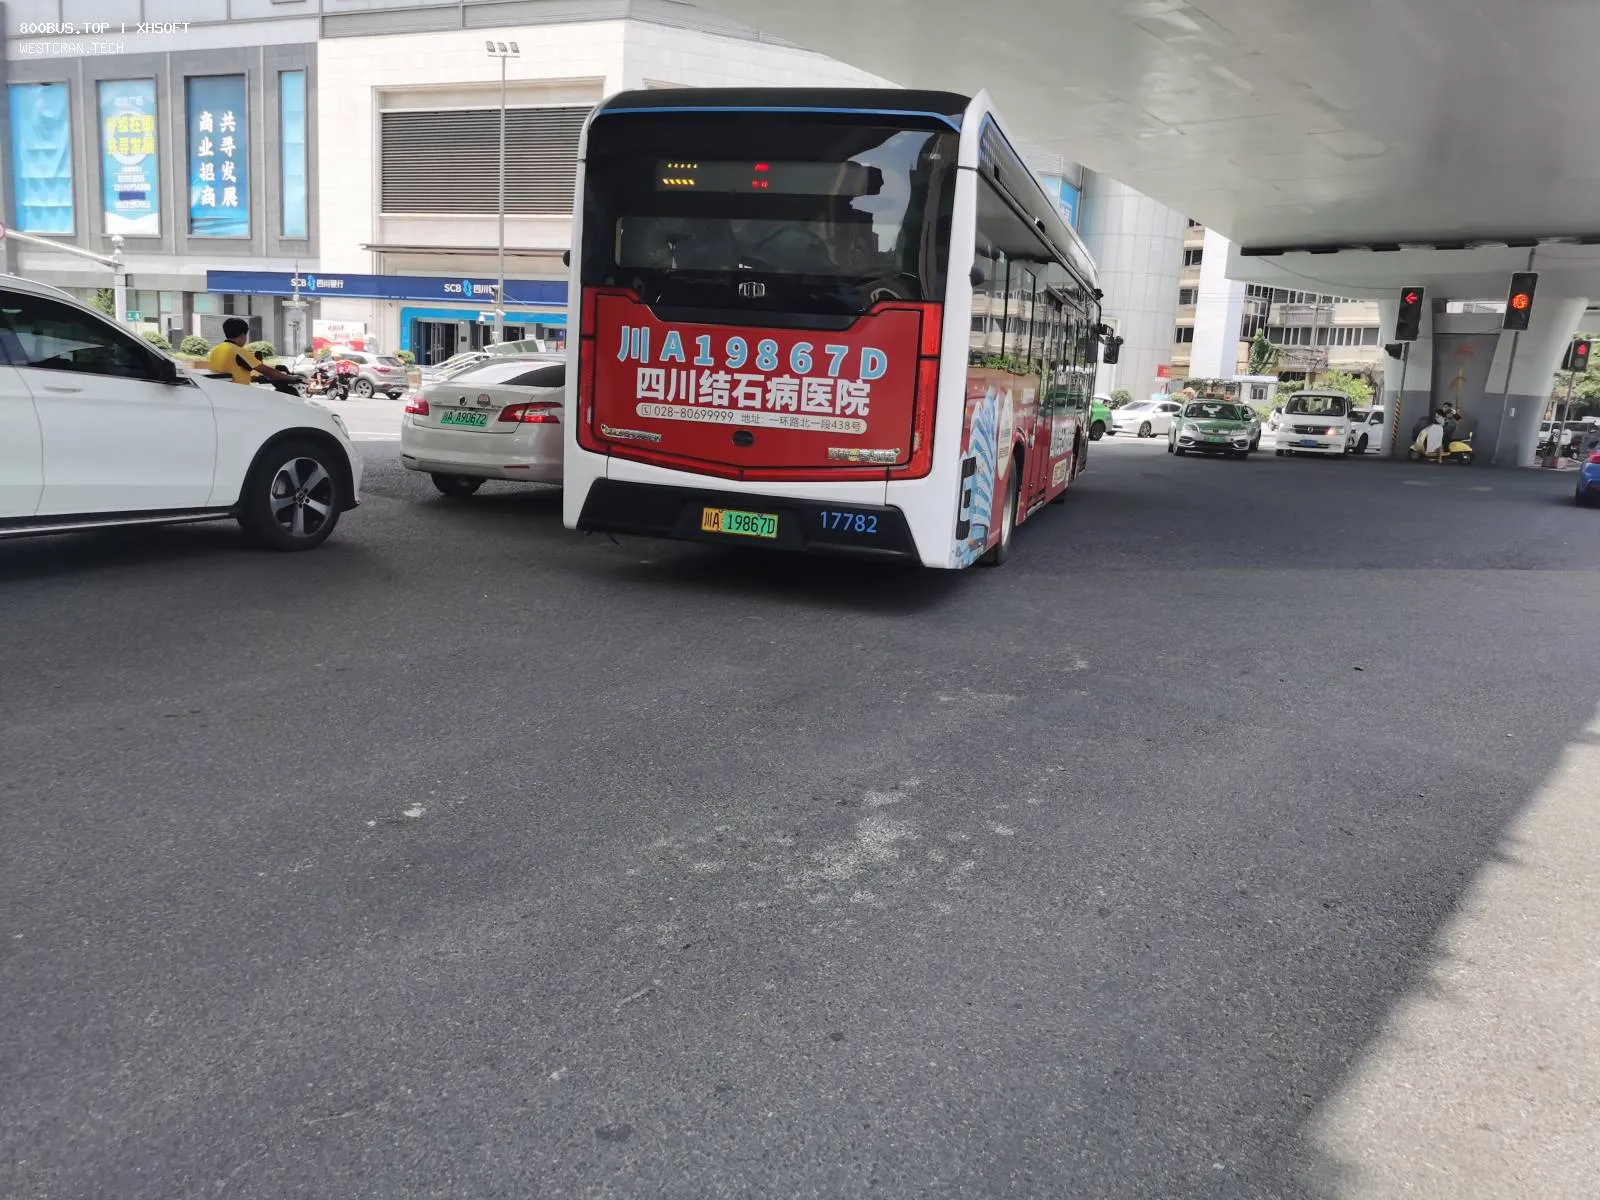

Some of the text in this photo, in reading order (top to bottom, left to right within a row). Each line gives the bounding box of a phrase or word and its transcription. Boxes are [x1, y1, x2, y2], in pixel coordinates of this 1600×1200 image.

[198, 110, 216, 208] 商业招商
[220, 110, 239, 207] 共寻发展
[290, 278, 344, 289] SCB 四川银行
[444, 283, 462, 293] SCB
[636, 367, 872, 417] 四川结石病医院
[653, 406, 735, 423] 028-80699999
[820, 511, 878, 533] 17782
